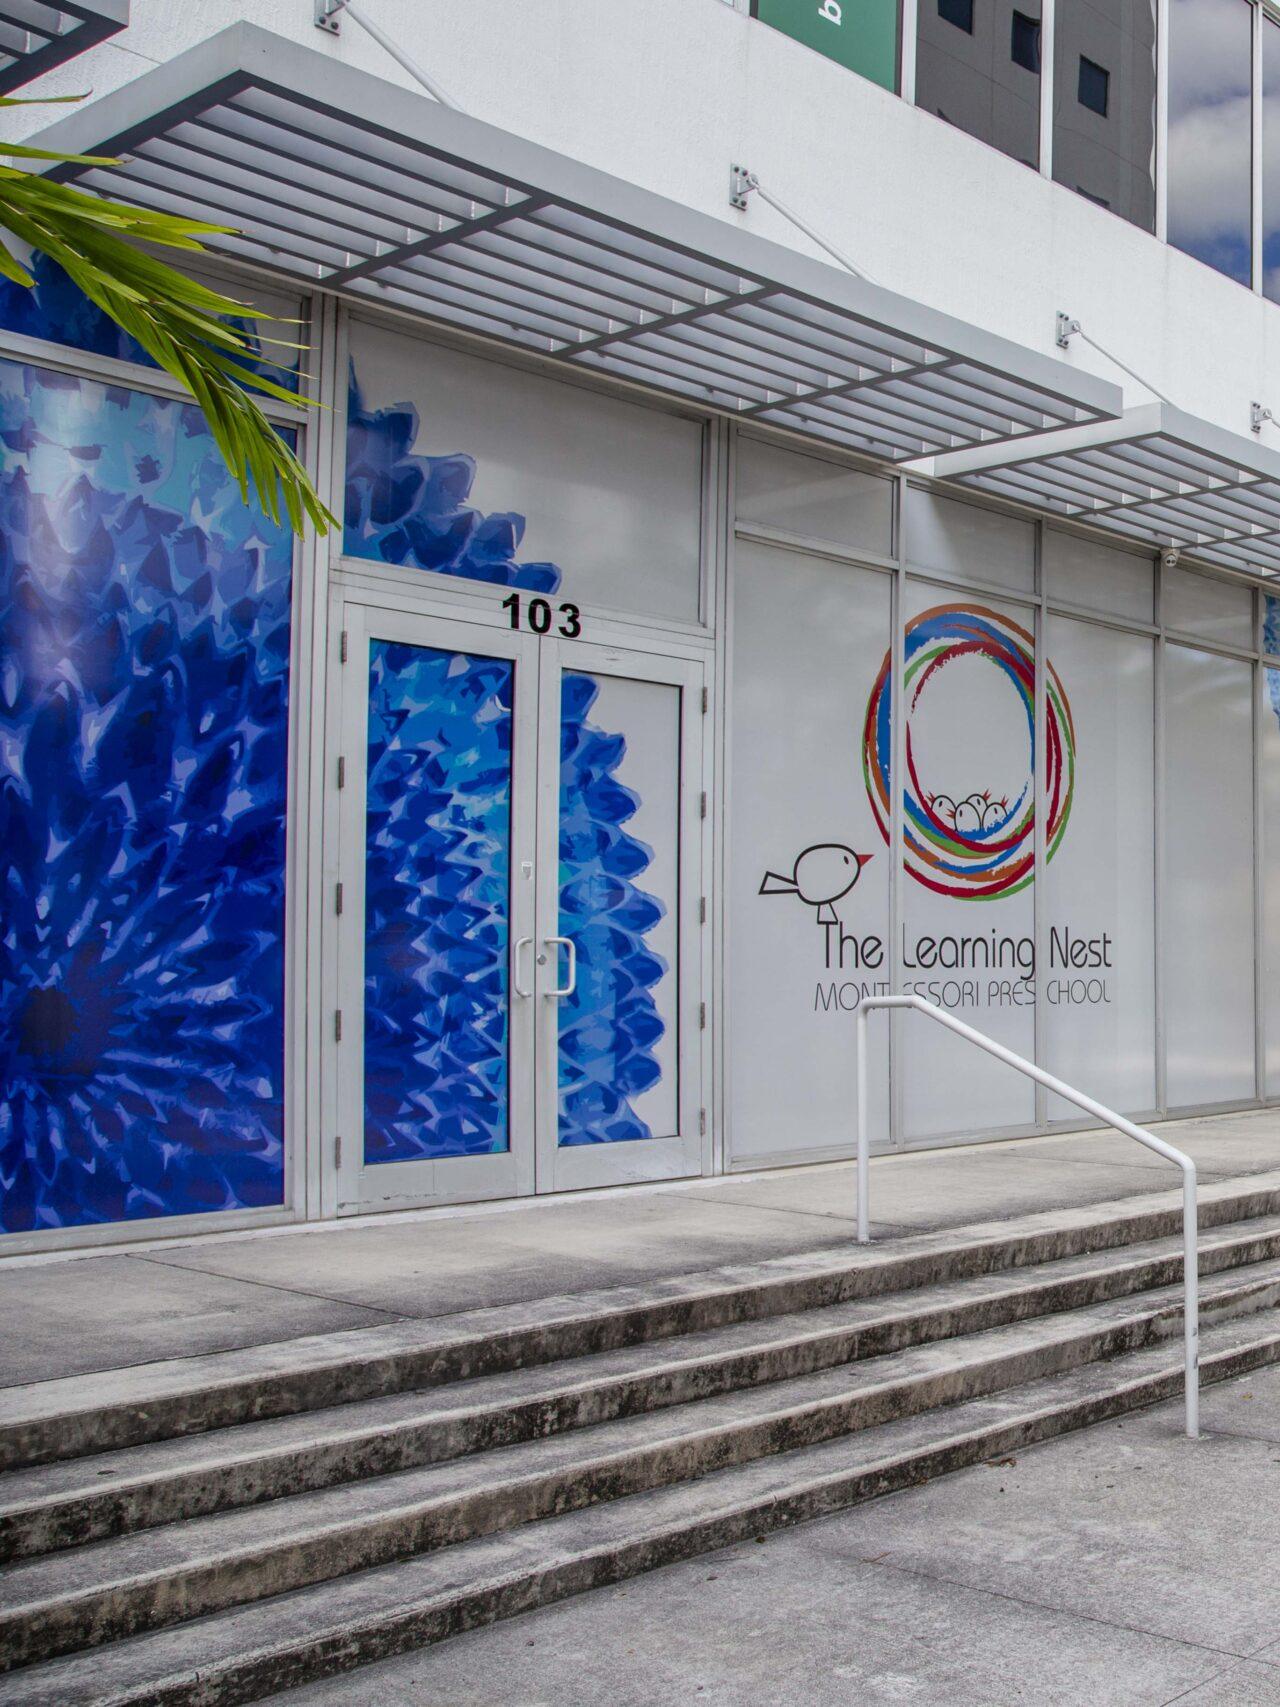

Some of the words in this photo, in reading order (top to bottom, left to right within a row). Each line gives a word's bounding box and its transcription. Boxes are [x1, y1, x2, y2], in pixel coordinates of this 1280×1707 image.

[502, 592, 581, 638] 103
[816, 920, 884, 969] The
[902, 922, 1035, 981] Learning
[1050, 926, 1112, 969] Nest
